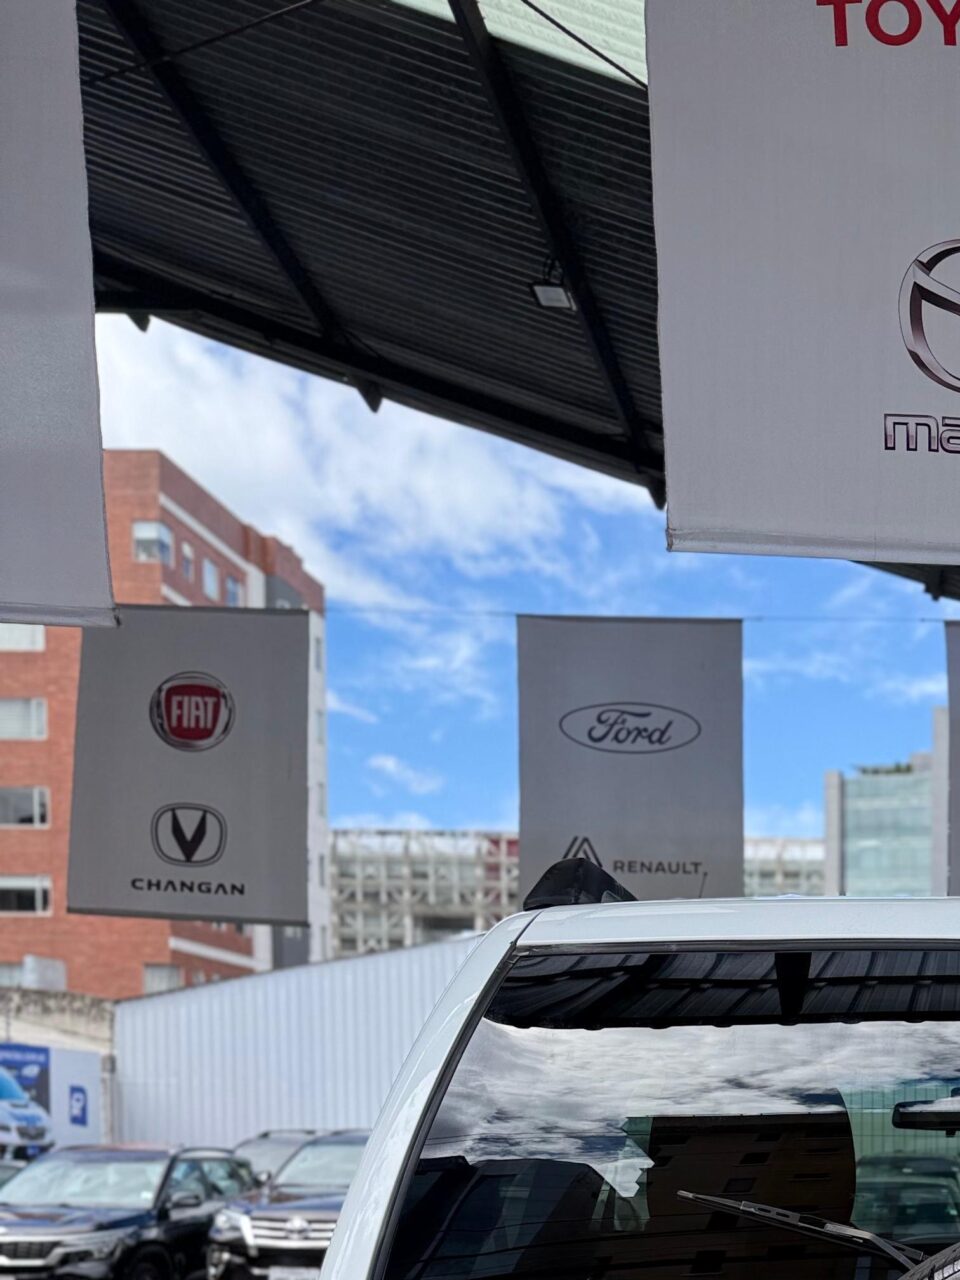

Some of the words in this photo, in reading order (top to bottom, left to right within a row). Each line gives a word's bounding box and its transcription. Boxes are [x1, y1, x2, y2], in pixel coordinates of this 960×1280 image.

[171, 695, 218, 729] FIAT
[587, 708, 673, 745] Ford
[613, 859, 703, 875] RENAULT
[130, 877, 245, 896] CHANGAN
